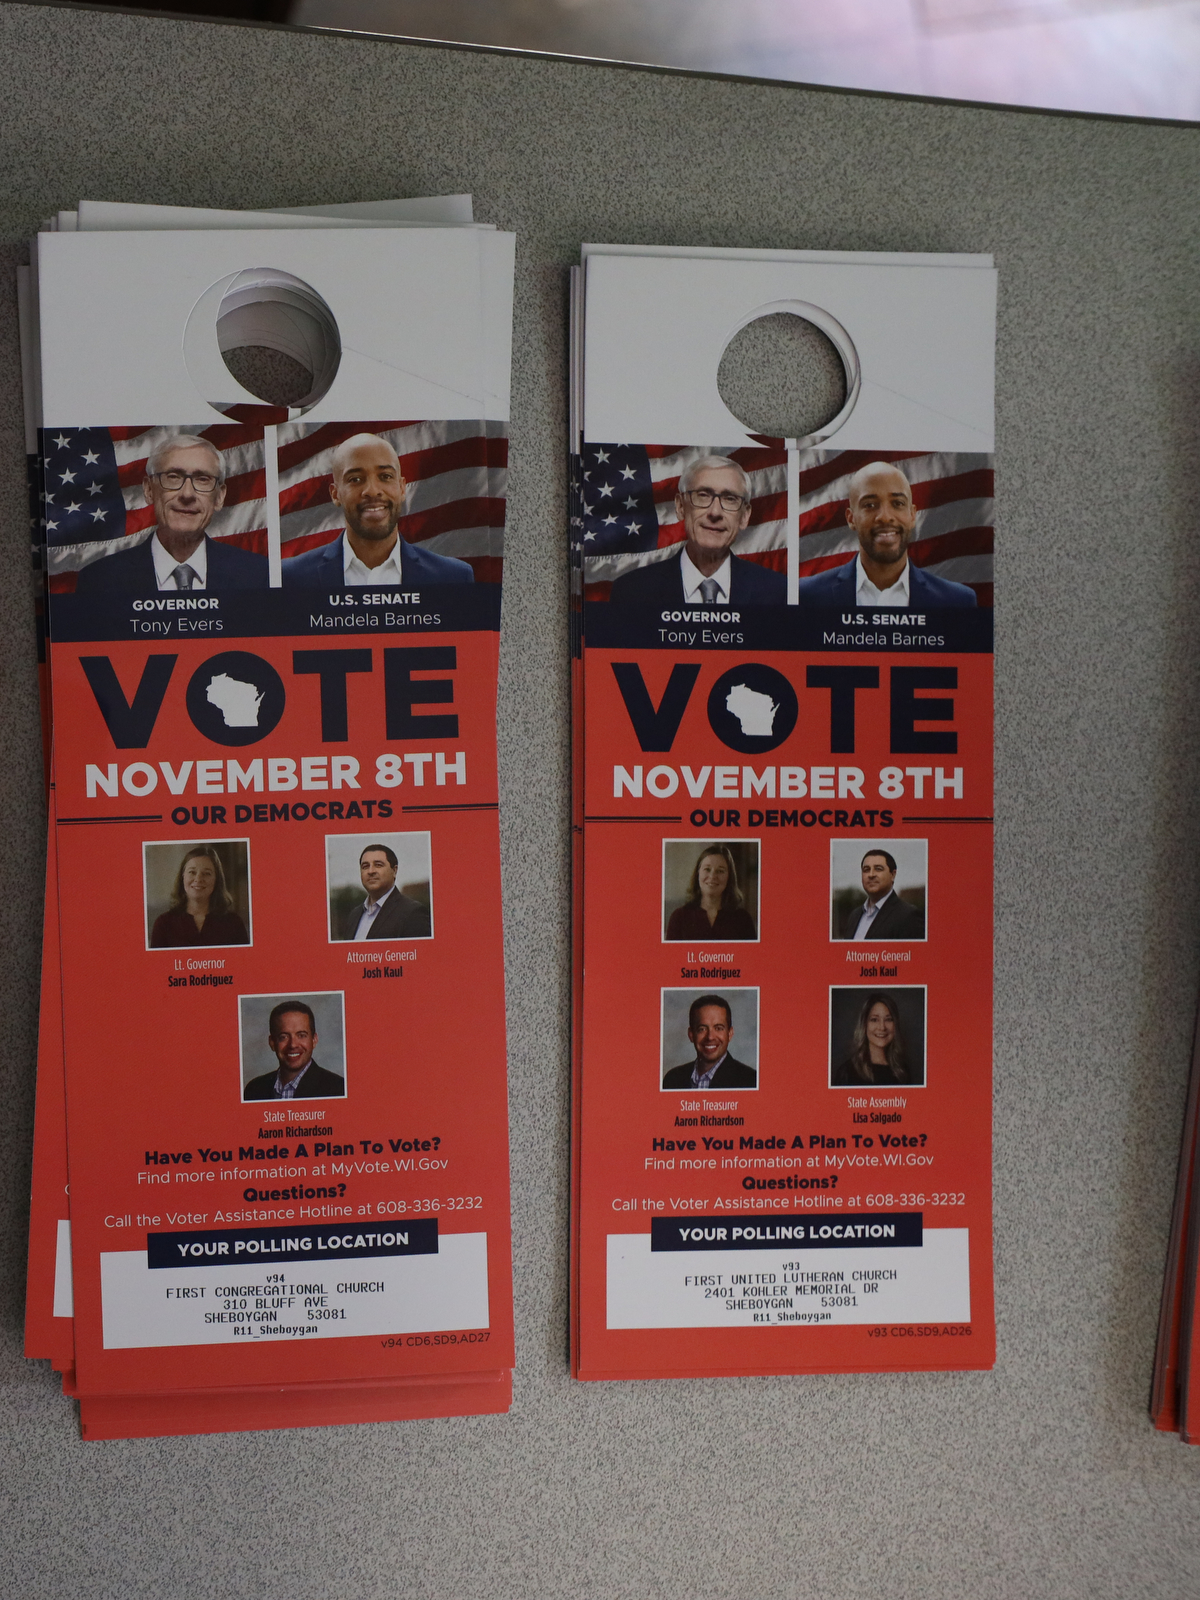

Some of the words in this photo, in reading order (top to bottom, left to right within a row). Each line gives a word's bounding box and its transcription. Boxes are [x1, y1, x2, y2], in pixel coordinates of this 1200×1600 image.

[132, 598, 219, 611] GOVERNOR
[329, 594, 358, 606] U.S.
[362, 593, 420, 605] SENATE
[310, 612, 379, 628] Mandela
[385, 610, 441, 626] Barnes
[661, 611, 740, 623] GOVERNOR
[842, 614, 868, 625] U.S.
[872, 614, 926, 625] SENATE
[130, 618, 172, 635] Tony
[178, 617, 223, 631] Evers
[658, 629, 697, 645] Tony
[702, 629, 744, 643] Evers
[823, 631, 887, 645] Mandela
[892, 632, 945, 646] Barnes
[78, 645, 460, 750] VOTE
[610, 662, 958, 755] VOTE
[86, 756, 361, 798] NOVEMBER
[375, 751, 466, 788] 8TH
[614, 765, 867, 799] NOVEMBER
[878, 766, 963, 799] 8TH
[171, 805, 227, 826] OUR
[235, 799, 393, 823] DEMOCRATS
[690, 809, 741, 827] OUR
[748, 809, 894, 827] DEMOCRATS
[347, 951, 383, 964] Attorney
[385, 949, 417, 962] General
[362, 967, 382, 979] Josh
[383, 966, 403, 978] Kaul
[645, 1157, 675, 1170] Find
[680, 1158, 717, 1169] more
[721, 1155, 802, 1169] information
[806, 1155, 820, 1167] at
[825, 1153, 934, 1170] MyVote.WI.Gov
[742, 1174, 838, 1190] Questions?
[243, 1183, 347, 1202] Questions?
[104, 1214, 132, 1228] Call
[136, 1214, 161, 1227] the
[166, 1212, 208, 1225] Voter
[213, 1206, 295, 1222] Assistance
[300, 1204, 353, 1218] Hotline
[357, 1203, 372, 1216] at
[376, 1196, 483, 1215] 608-336-3232
[679, 1228, 727, 1241] YOUR
[732, 1226, 805, 1240] POLLING
[810, 1224, 895, 1239] LOCATION
[177, 1242, 229, 1257] YOUR
[234, 1237, 312, 1255] POLLING
[317, 1232, 409, 1251] LOCATION
[782, 1262, 800, 1271] v93
[266, 1274, 285, 1283] v94
[685, 1275, 723, 1286] FIRST
[731, 1273, 776, 1285] UNITED
[784, 1271, 844, 1283] LUTHERAN
[852, 1269, 897, 1281] CHURCH
[166, 1287, 206, 1299] FIRST
[215, 1283, 328, 1297] CONGREGATIONAL
[336, 1281, 384, 1294] CHURCH
[705, 1287, 735, 1298] 2401
[743, 1285, 787, 1297] KOHLER
[795, 1283, 855, 1295] MEMORIAL
[863, 1282, 878, 1293] DR
[223, 1299, 247, 1310] 310
[255, 1297, 296, 1309] BLUFF
[304, 1296, 328, 1308] AVE
[726, 1298, 793, 1310] SHEBOYGAN
[821, 1296, 858, 1307] 53081
[204, 1311, 277, 1323] SHEBOYGAN
[307, 1308, 347, 1320] 53081
[753, 1311, 831, 1324] R11_Sheboygan
[234, 1323, 318, 1338] R11_Sheboygan
[868, 1327, 887, 1337] v93
[381, 1338, 402, 1348] v94
